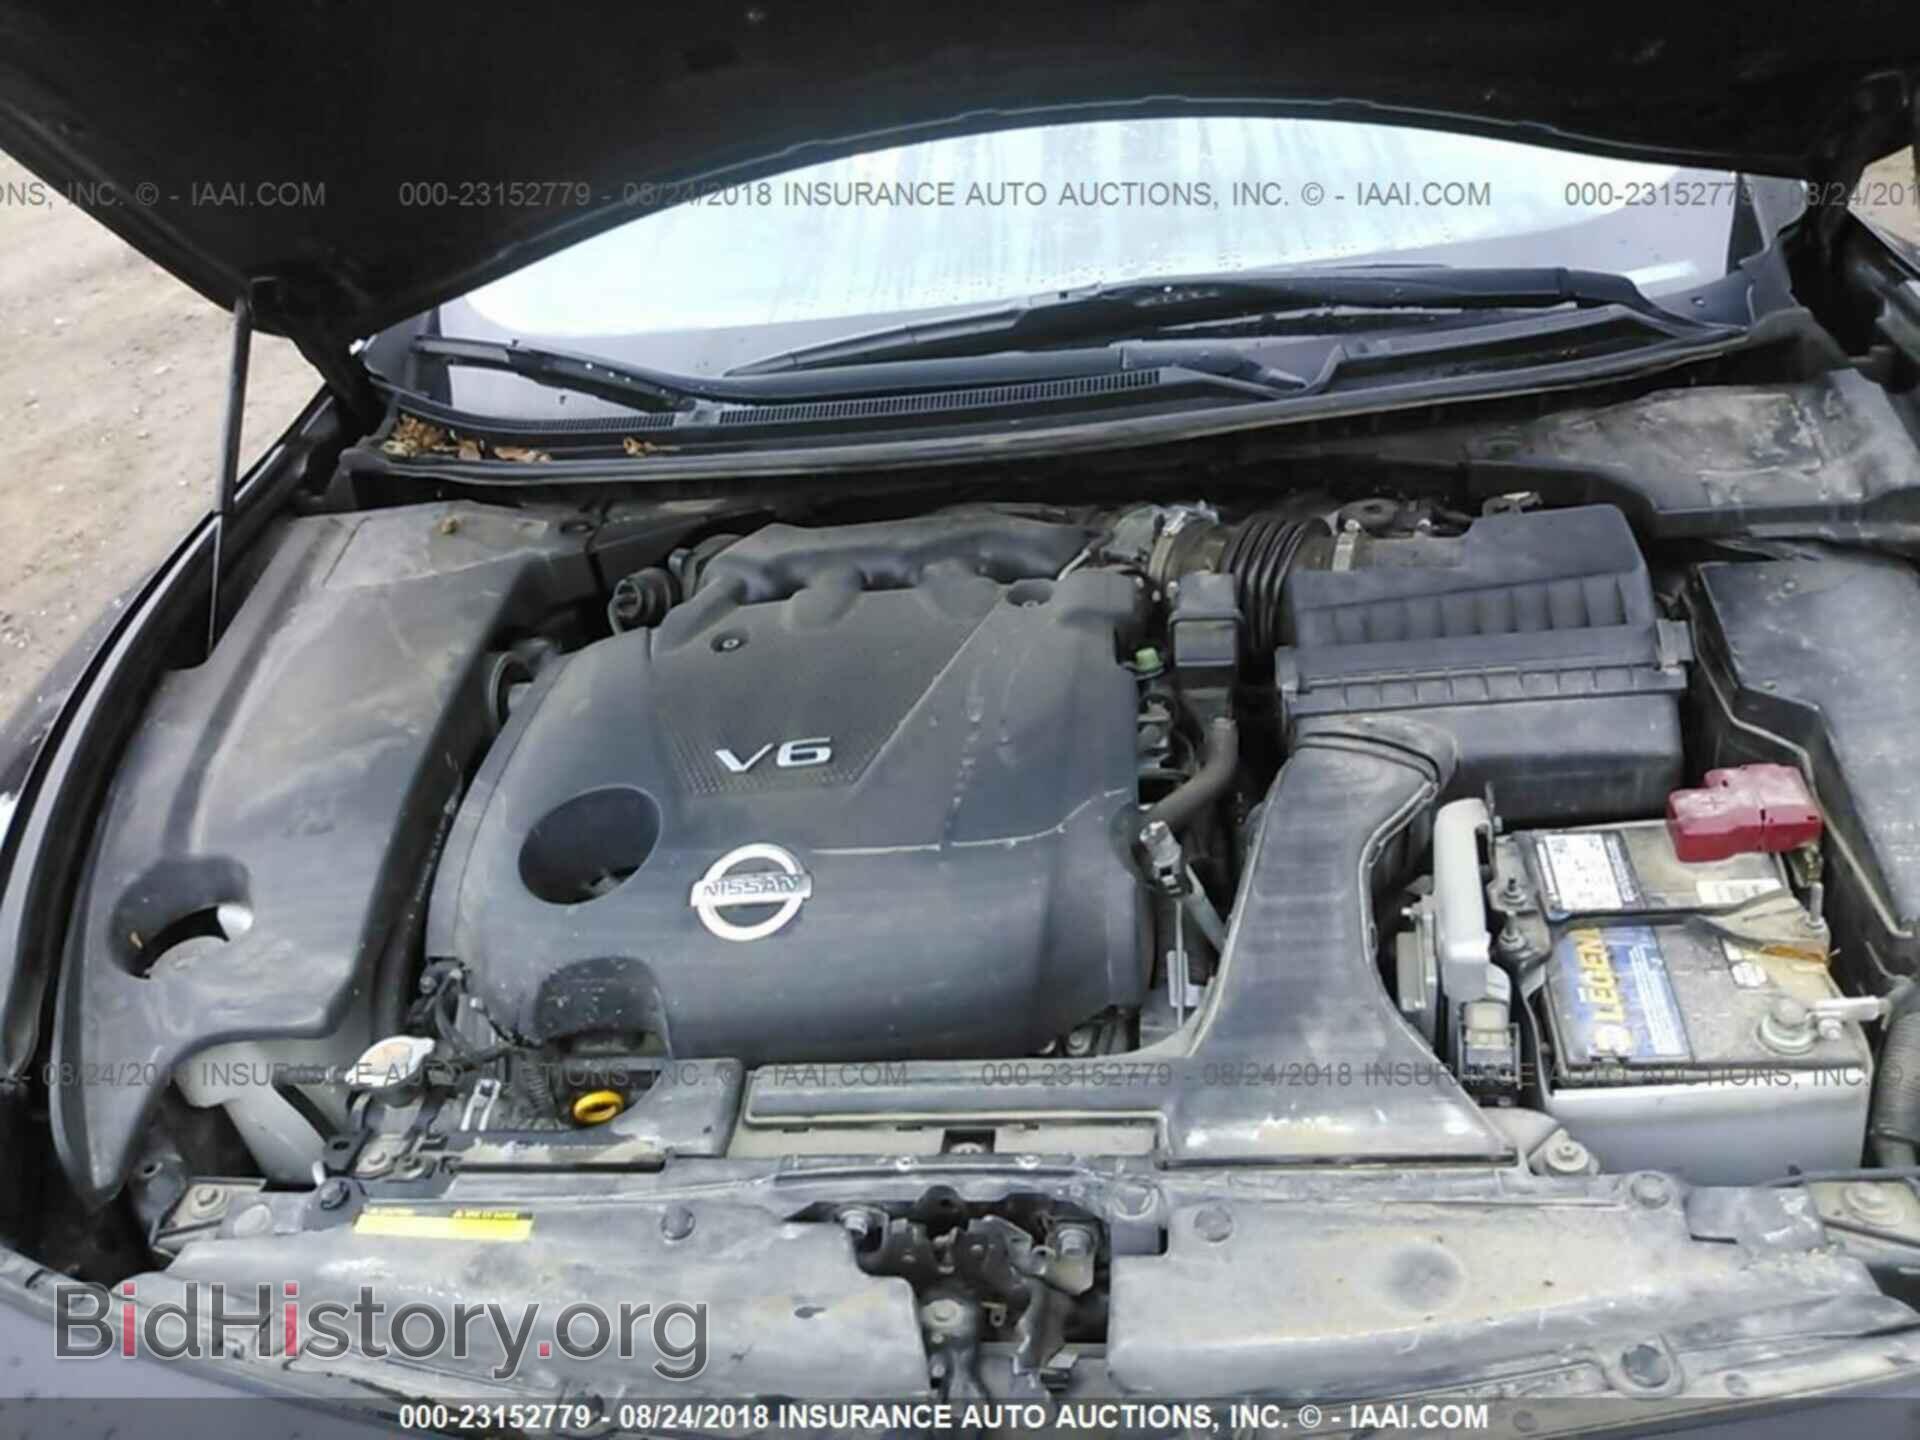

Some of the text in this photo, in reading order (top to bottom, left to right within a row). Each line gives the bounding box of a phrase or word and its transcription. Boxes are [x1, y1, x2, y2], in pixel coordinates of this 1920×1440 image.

[715, 737, 832, 772] V6
[703, 874, 800, 896] NISSAN
[1573, 926, 1625, 1024] LEGEN
